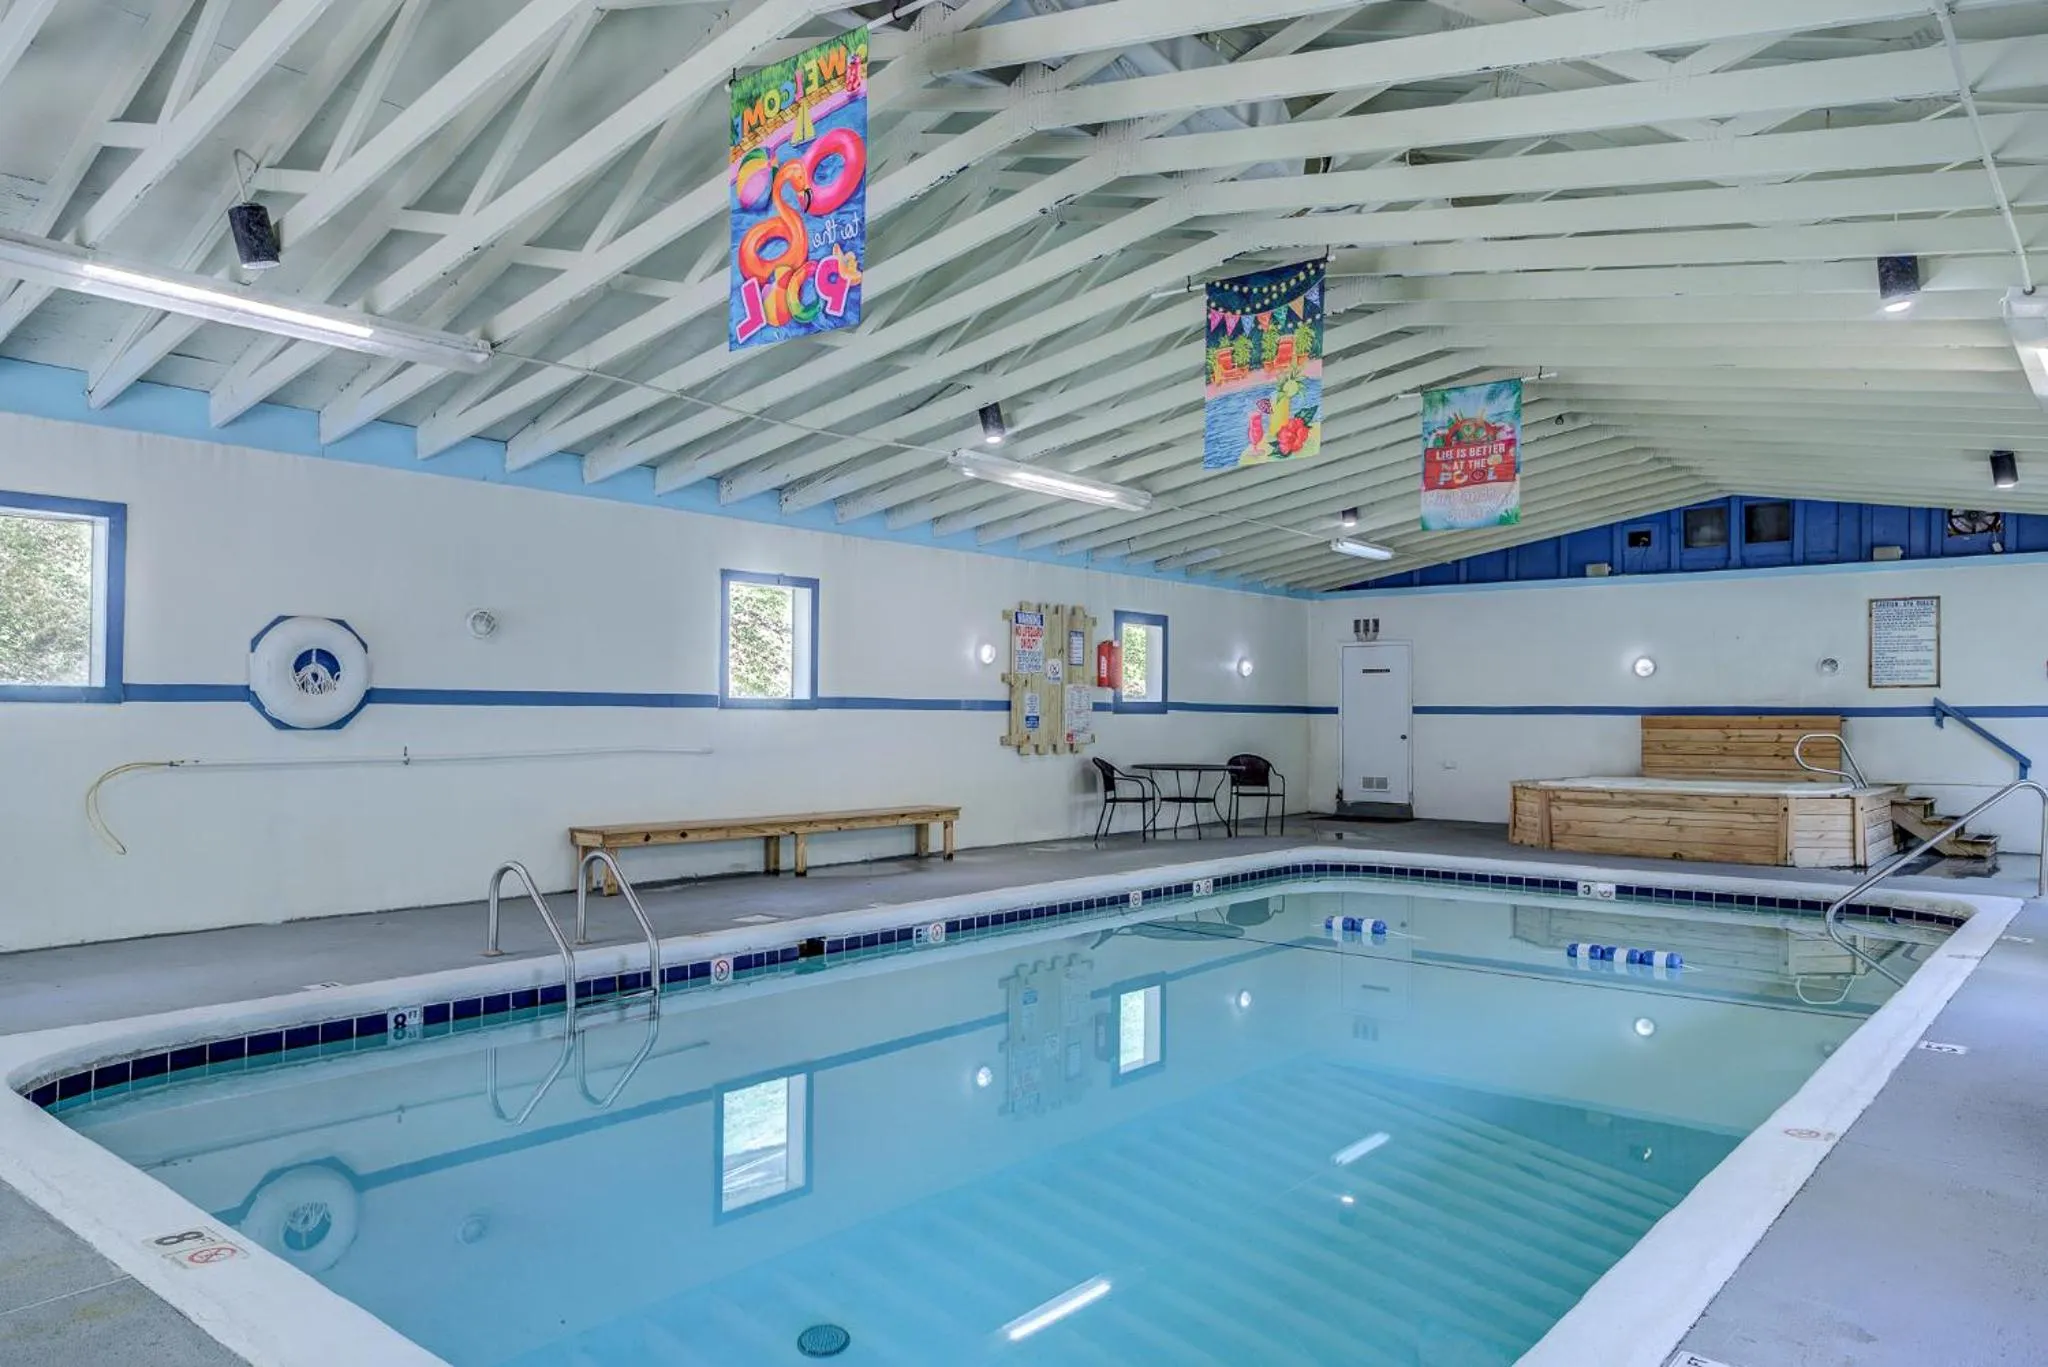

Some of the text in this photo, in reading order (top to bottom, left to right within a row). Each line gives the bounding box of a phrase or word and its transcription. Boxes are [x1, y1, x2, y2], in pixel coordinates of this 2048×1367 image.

[1436, 443, 1506, 461] LIFE IS BETTER
[1453, 458, 1487, 471] AT THE
[1018, 613, 1041, 625] WARNING
[1583, 885, 1591, 895] 3
[393, 1013, 407, 1030] 8
[154, 1231, 204, 1246] 8
